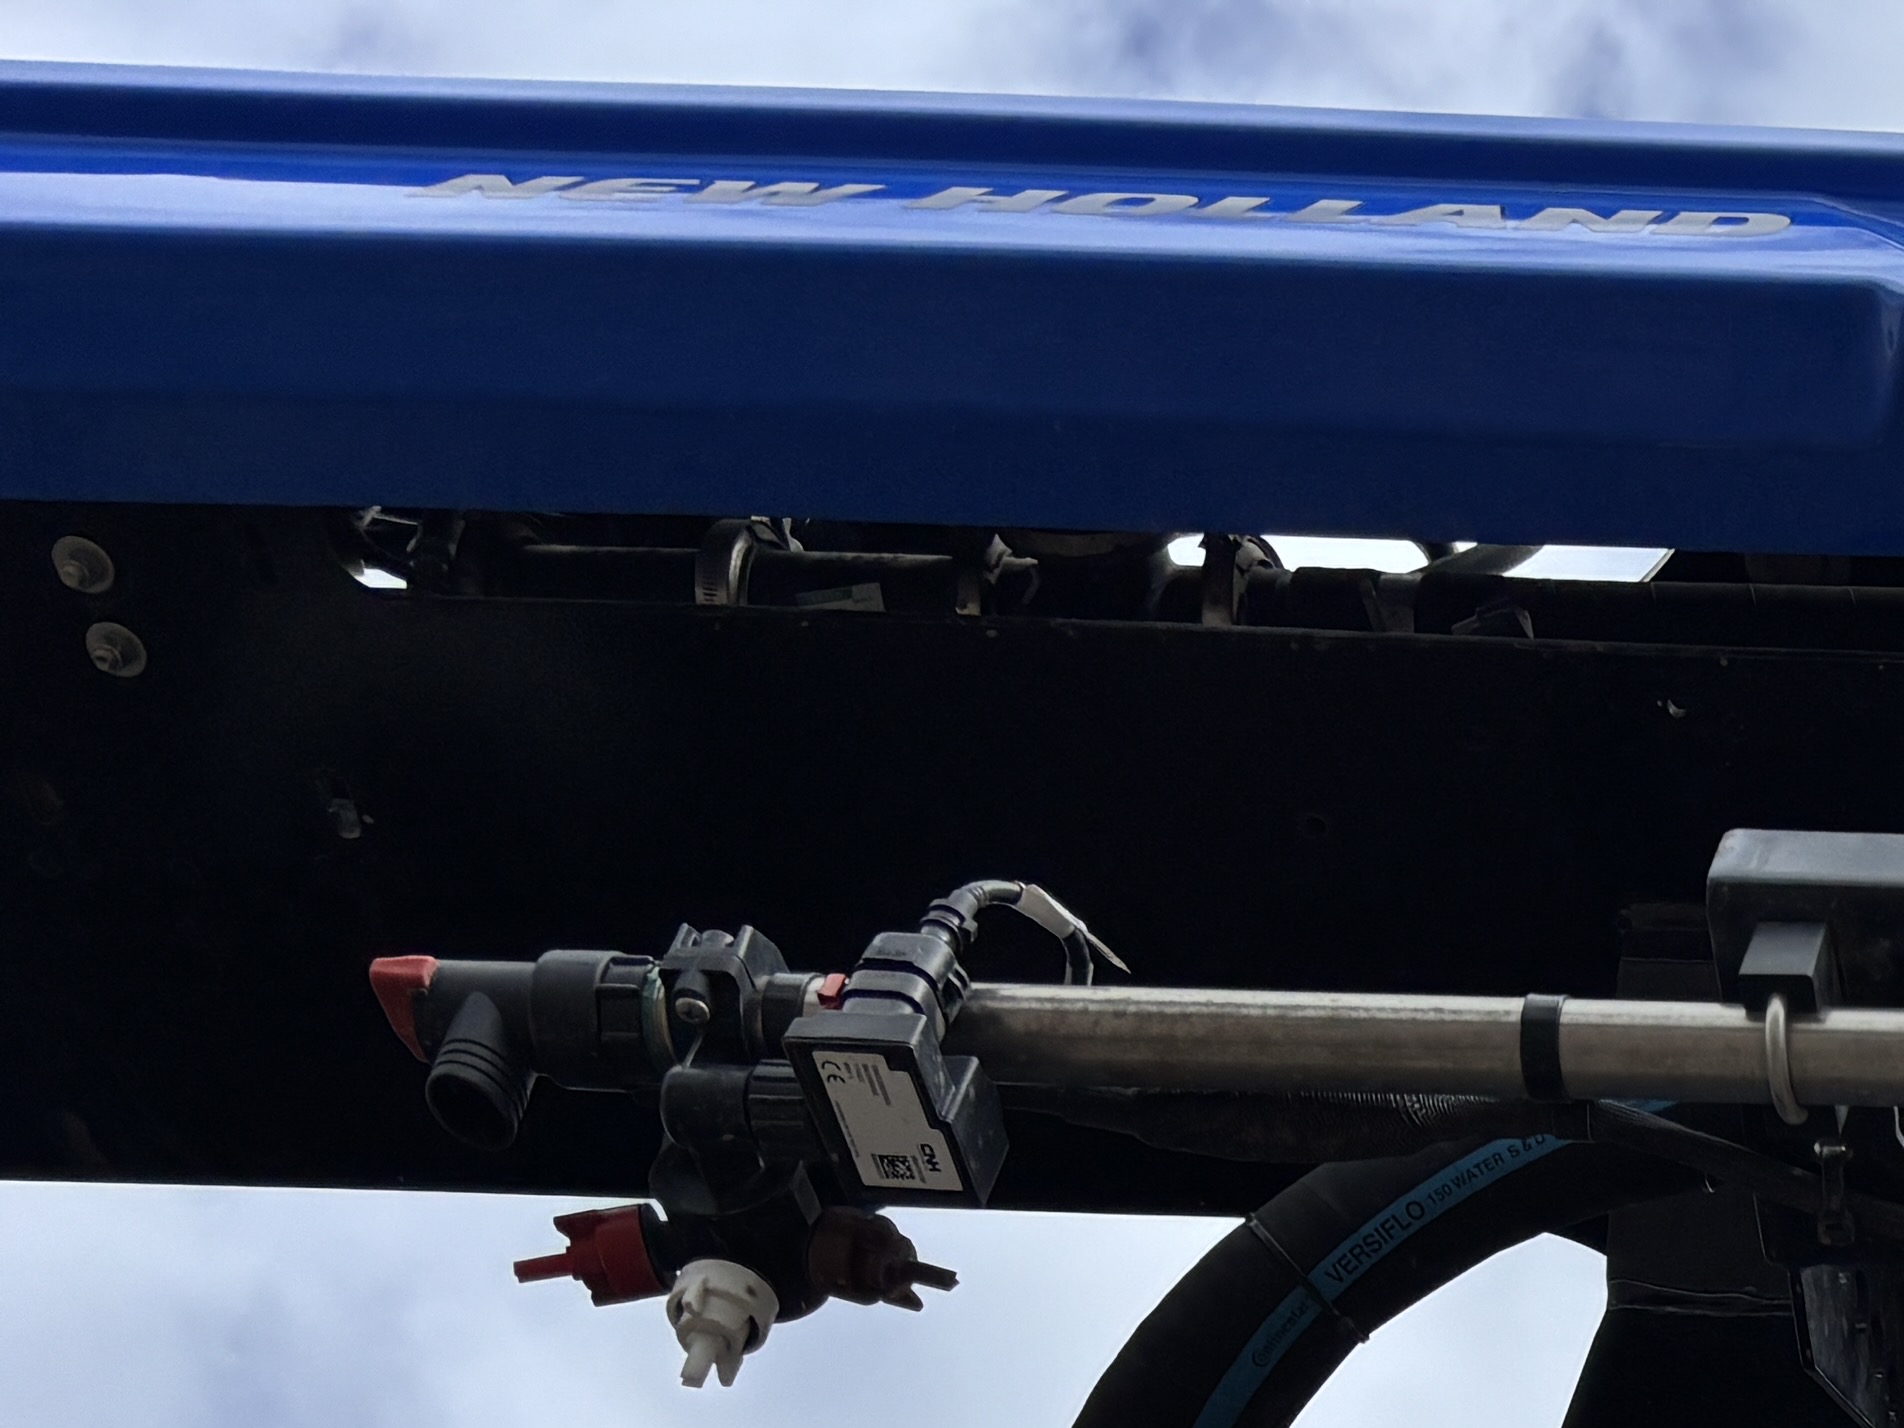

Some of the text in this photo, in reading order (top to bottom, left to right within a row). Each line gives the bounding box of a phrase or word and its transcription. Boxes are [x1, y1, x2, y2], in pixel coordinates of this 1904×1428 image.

[404, 173, 1792, 236] NEW HOLLAND
[920, 1143, 942, 1173] CNH
[1323, 1200, 1426, 1283] VERSIFLO
[1427, 1179, 1453, 1204] 150
[1451, 1152, 1506, 1190] WATER
